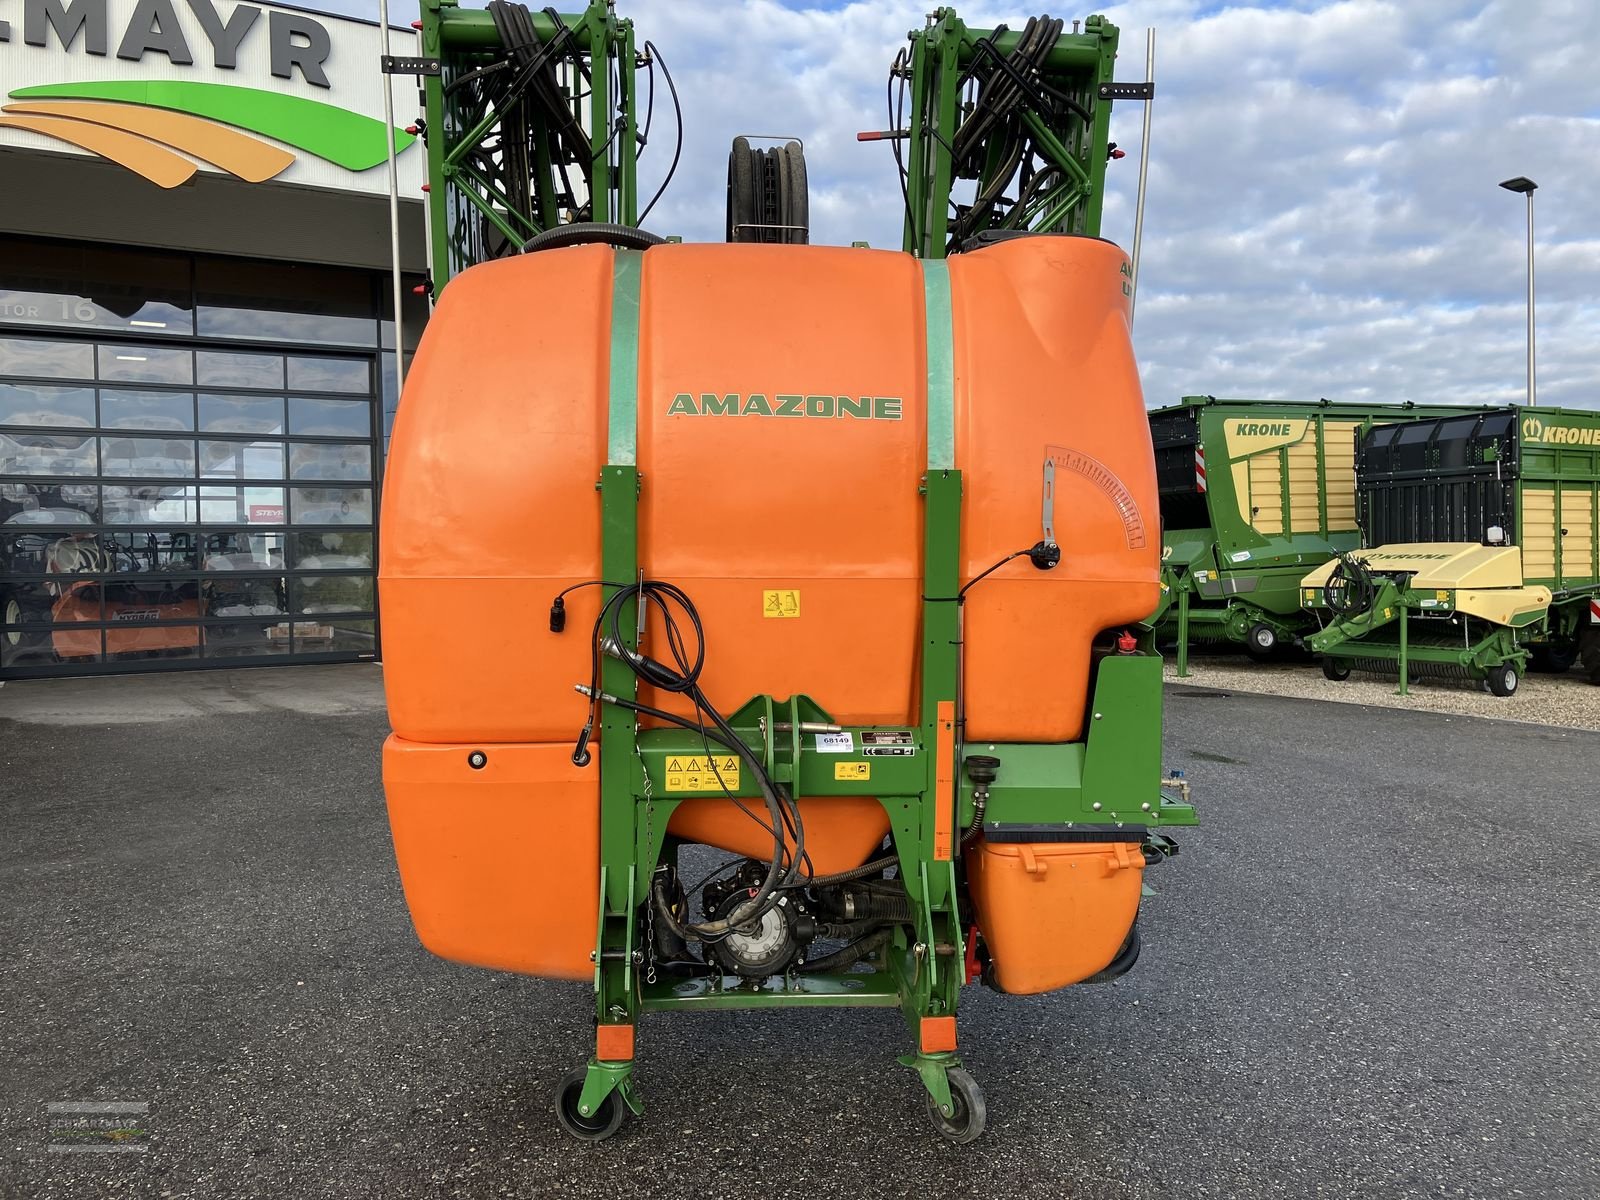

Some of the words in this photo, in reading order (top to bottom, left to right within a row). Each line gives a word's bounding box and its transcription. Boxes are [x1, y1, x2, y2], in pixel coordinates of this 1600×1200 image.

[0, 0, 331, 89] MAYR
[57, 299, 97, 321] 16
[666, 393, 903, 420] AMAZONE
[1236, 423, 1291, 436] KRONE
